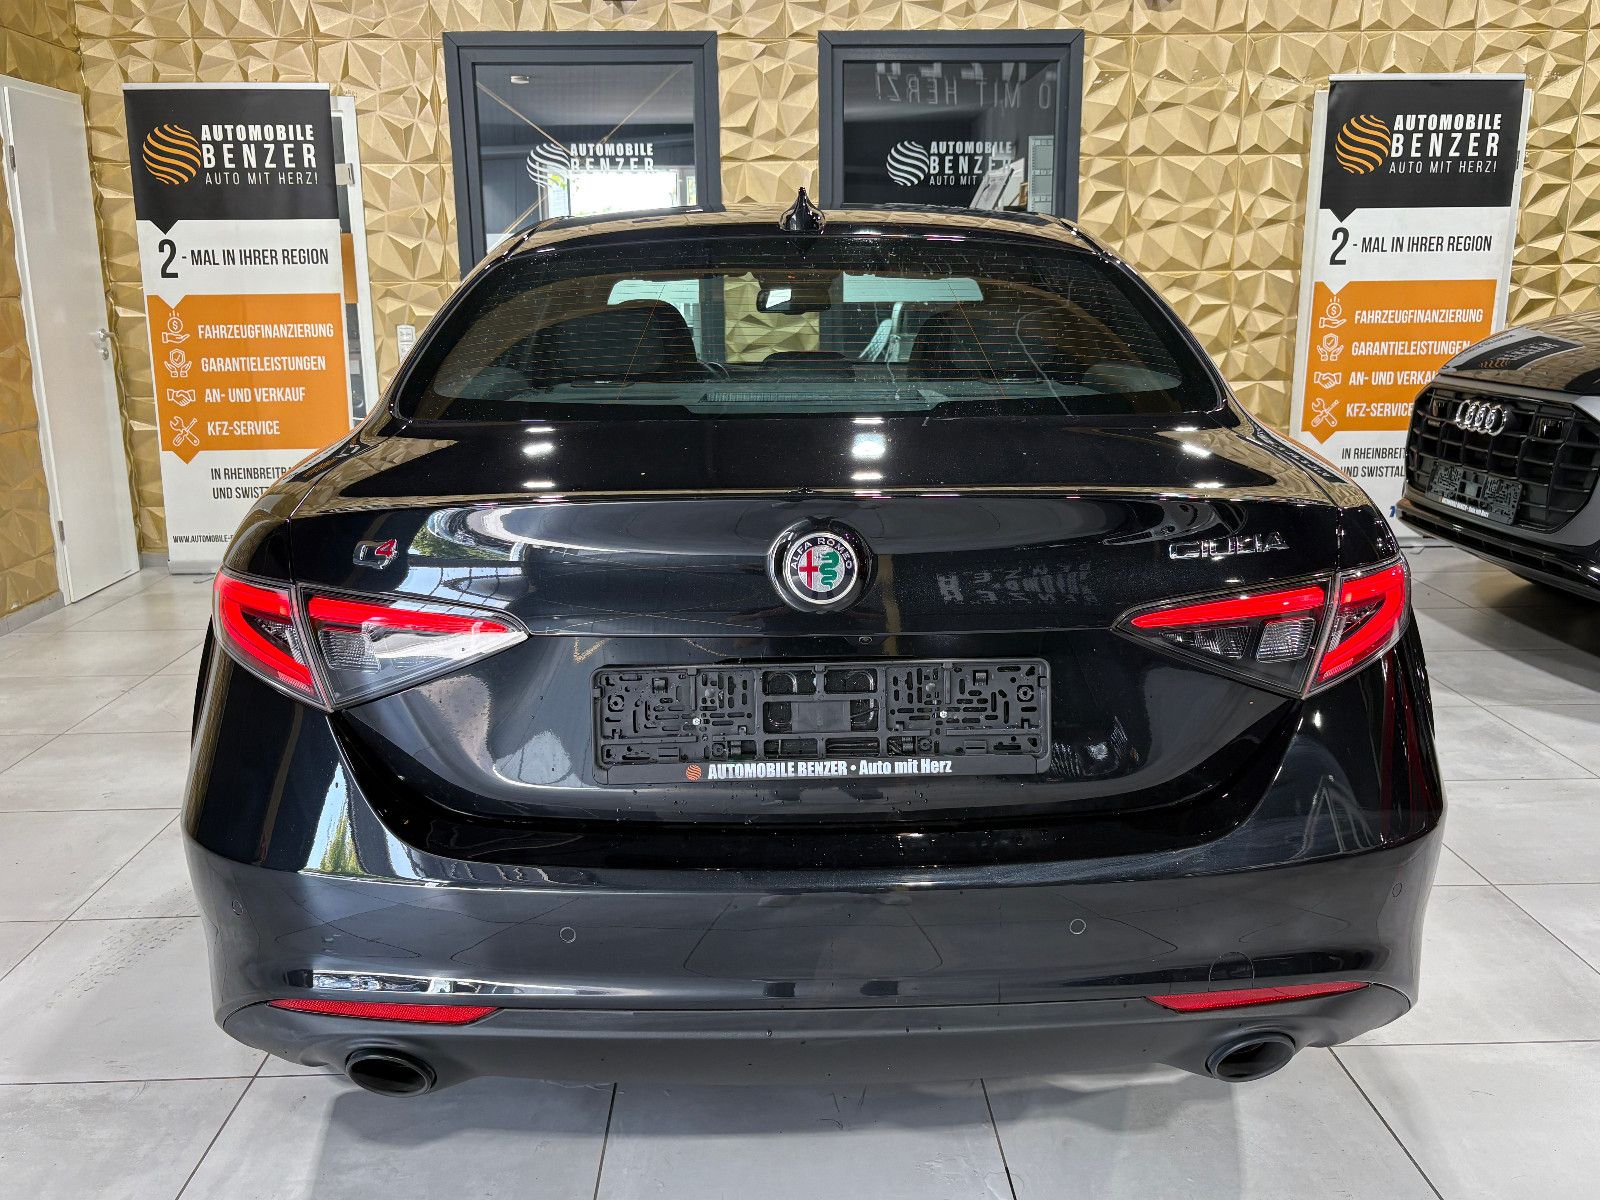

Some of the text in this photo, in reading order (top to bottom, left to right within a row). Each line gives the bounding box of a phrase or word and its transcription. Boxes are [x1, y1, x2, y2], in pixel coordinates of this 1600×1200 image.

[1393, 114, 1502, 131] AUTOMOBILE
[201, 124, 314, 142] AUTOMOBILE
[570, 143, 654, 156] AUTOMOBILE
[930, 141, 1012, 154] AUTOMOBILE
[1390, 133, 1499, 158] BENZER
[202, 143, 317, 169] BENZER
[929, 155, 1012, 174] BENZER
[1389, 160, 1497, 174] AUTO MIT HERZ!
[205, 171, 319, 185] AUTO MIT HERZ!
[929, 175, 955, 186] AUTO
[960, 175, 977, 186] MIT
[1329, 227, 1350, 265] 2
[1361, 236, 1388, 253] MAL
[1390, 236, 1404, 252] IN
[1407, 236, 1444, 252] IHRER
[1447, 235, 1493, 251] REGION
[158, 238, 179, 279] 2
[190, 249, 219, 266] MAL
[223, 249, 236, 266] IN
[239, 249, 279, 265] IHRER
[281, 248, 329, 265] REGION
[1354, 308, 1483, 324] FAHRZEUGFINANZIERUNG
[198, 323, 334, 339] FAHRZEUGFINANZIERUNG
[201, 356, 326, 372] GARANTIELEISTUNGEN
[1348, 371, 1369, 386] AN-
[1371, 371, 1395, 385] UND
[205, 387, 306, 403] AN- UND VERKAUF
[1346, 402, 1414, 417] KFZ-SERVICE
[207, 420, 281, 436] KFZ-SERVICE
[1341, 447, 1352, 459] IN
[211, 468, 221, 480] IN
[212, 487, 233, 499] UND
[791, 537, 853, 570] ALFA ROMEO
[707, 757, 953, 780] AUTOMOBILE BENZER Auto mit Herz
